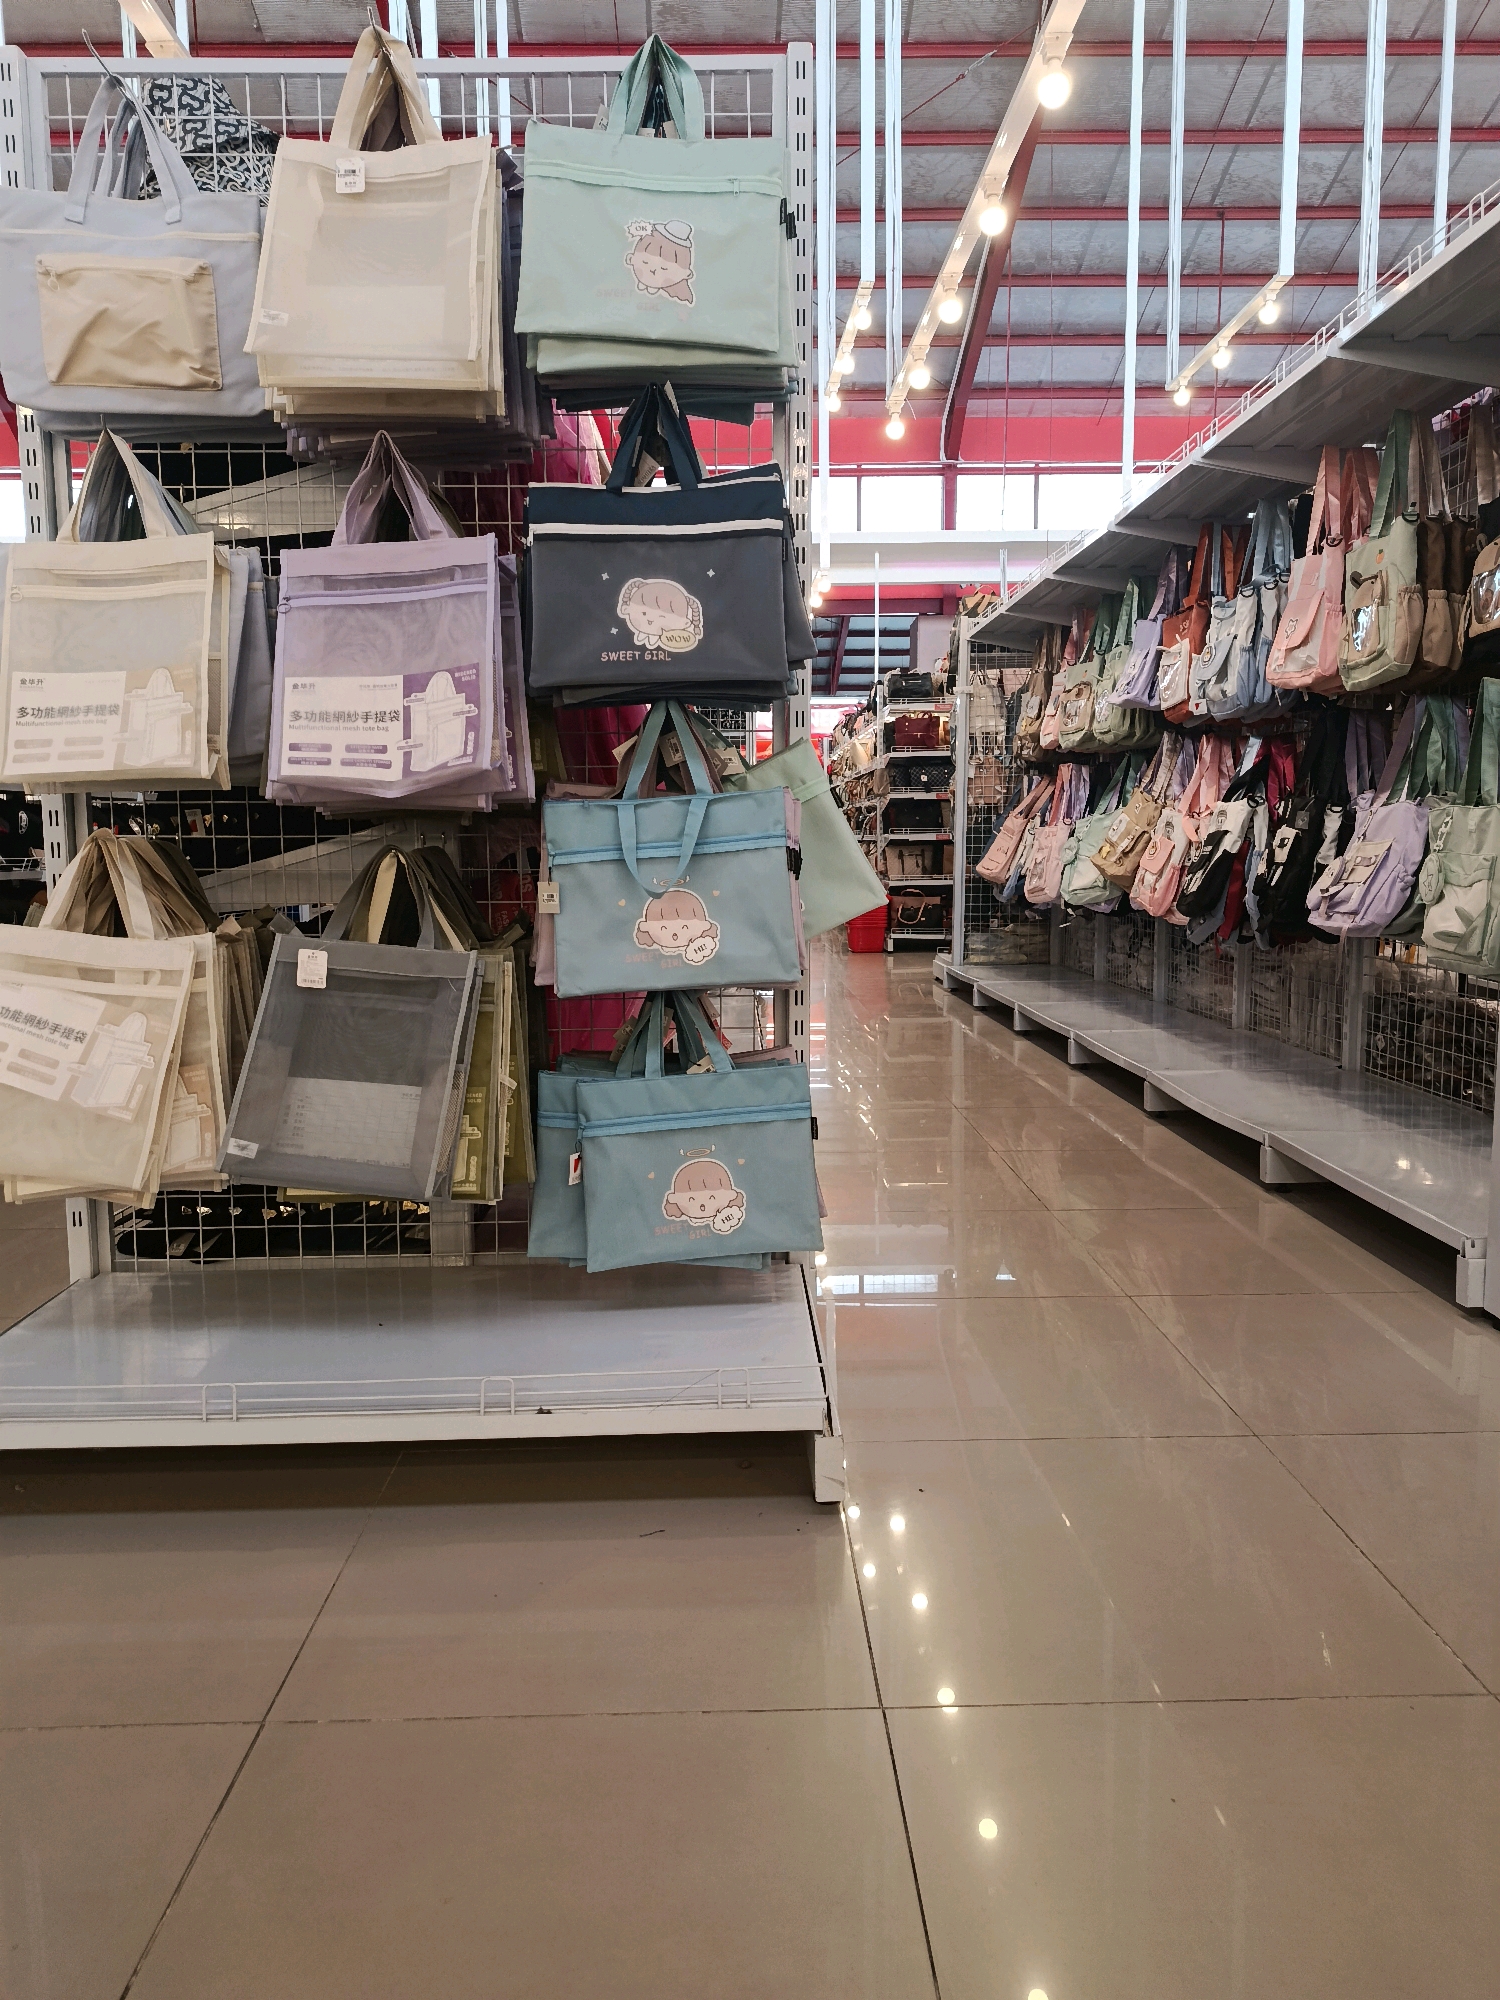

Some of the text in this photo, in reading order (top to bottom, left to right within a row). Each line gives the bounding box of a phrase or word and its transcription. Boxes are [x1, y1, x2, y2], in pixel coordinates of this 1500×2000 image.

[666, 635, 690, 643] WOW
[601, 651, 671, 661] SWEET GIRL
[17, 704, 119, 719] 多功能網紗手提袋
[290, 709, 401, 724] 多功能網紗手提袋
[654, 1224, 687, 1236] SWEET
[689, 1229, 712, 1240] GIRL
